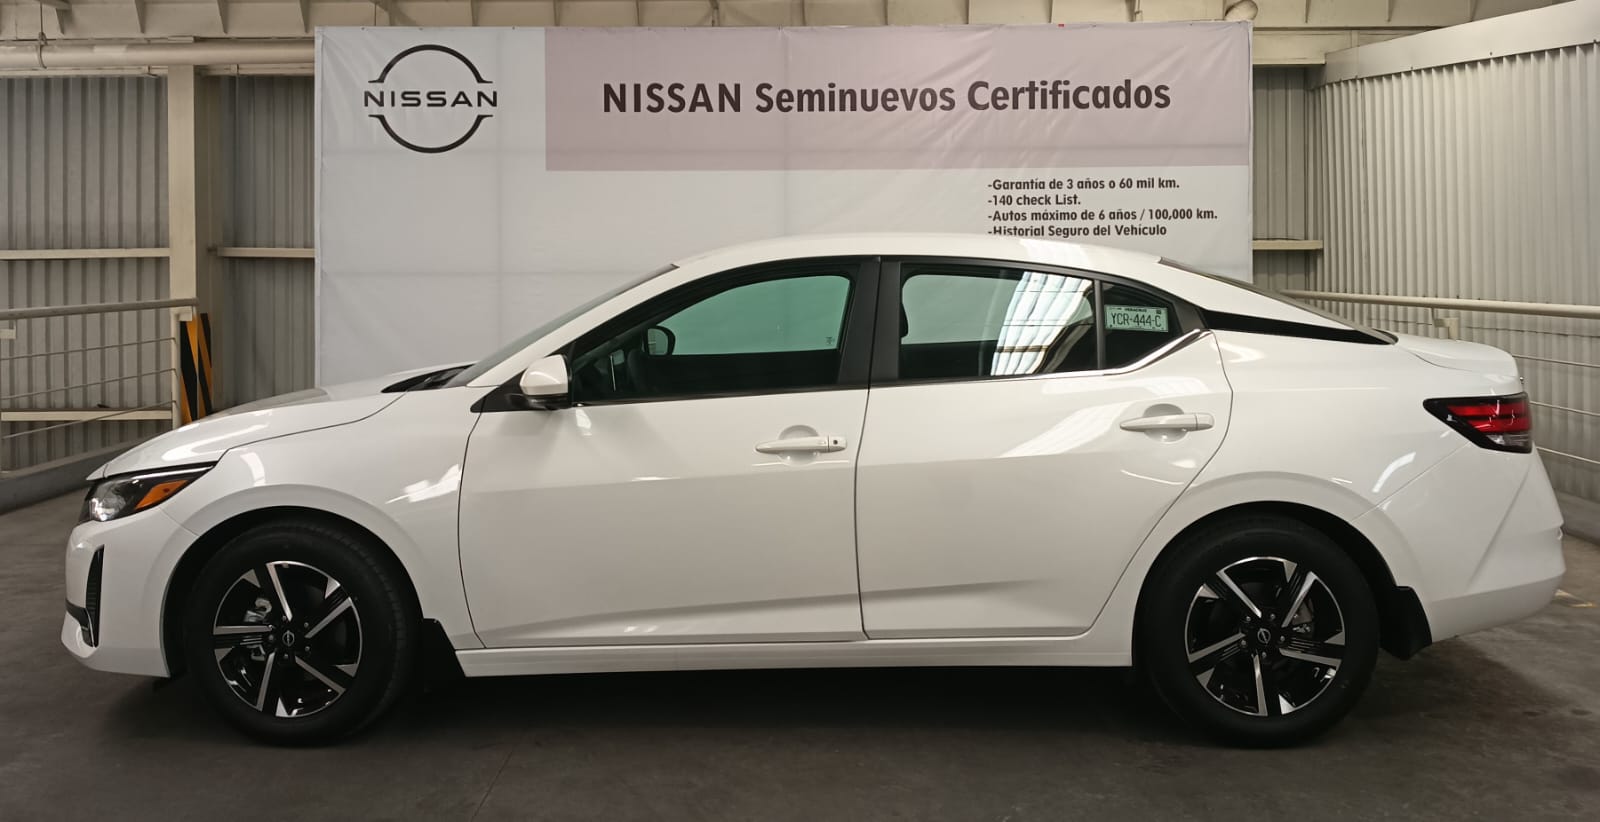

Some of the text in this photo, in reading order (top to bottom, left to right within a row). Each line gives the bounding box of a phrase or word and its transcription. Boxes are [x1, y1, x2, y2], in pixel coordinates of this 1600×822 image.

[364, 90, 498, 108] NISSAN
[603, 78, 1171, 114] NISSAN Seminuevos Certificados
[987, 177, 1180, 191] -Garantía de 3 años o 60 mil km.
[987, 194, 1081, 206] -140 check List.
[987, 208, 1218, 222] -Autos máximo de 6 años / 100,000 km.
[987, 223, 1168, 239] -Historial Seguro del Vehículo
[1111, 312, 1162, 328] YCR-444-C
